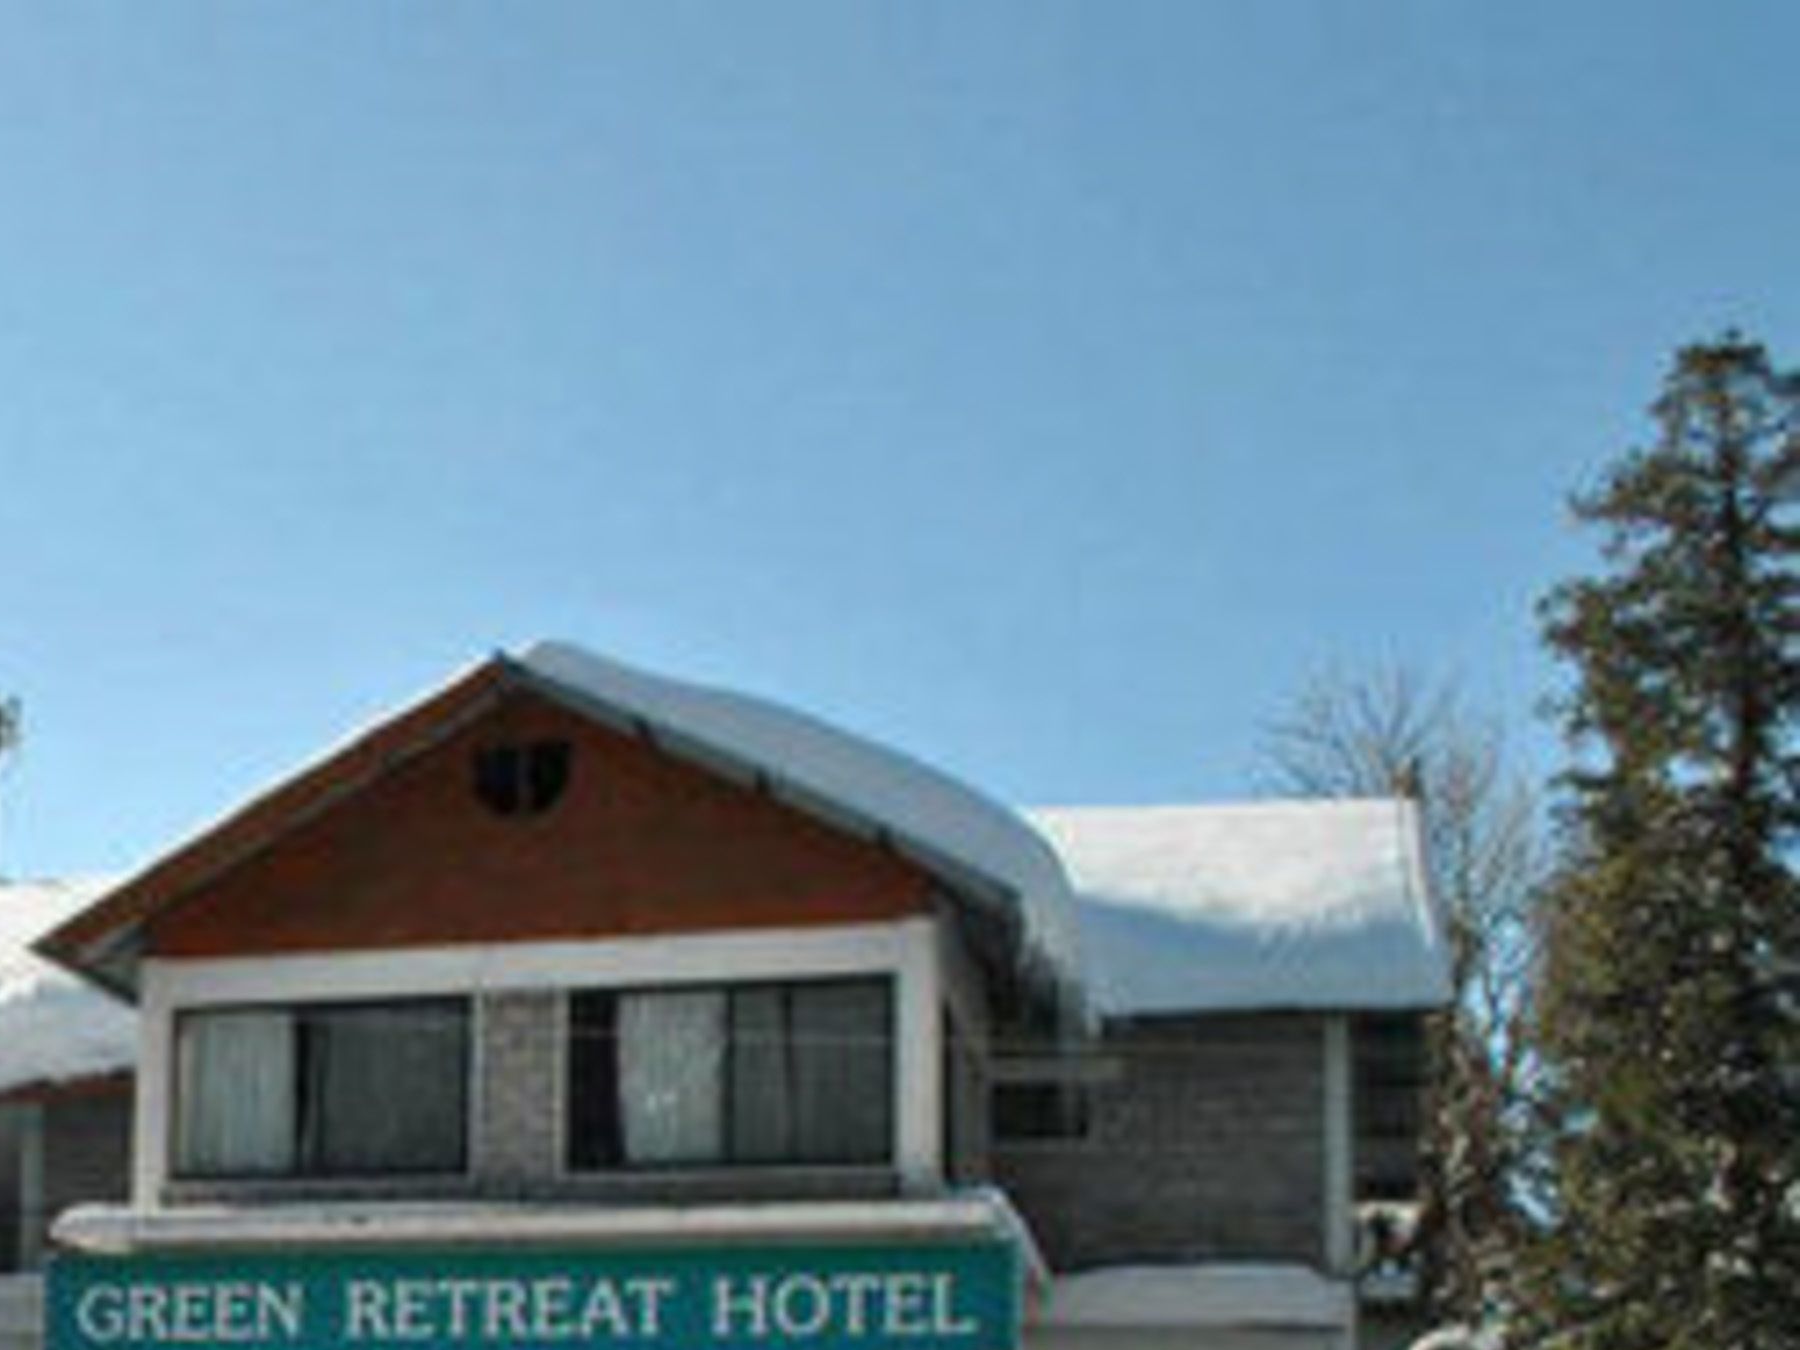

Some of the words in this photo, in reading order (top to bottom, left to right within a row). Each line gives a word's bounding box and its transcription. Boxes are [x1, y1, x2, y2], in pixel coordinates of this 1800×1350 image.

[76, 1284, 301, 1342] GREEN
[344, 1277, 674, 1339] RETREAT
[712, 1271, 979, 1336] HOTEL
